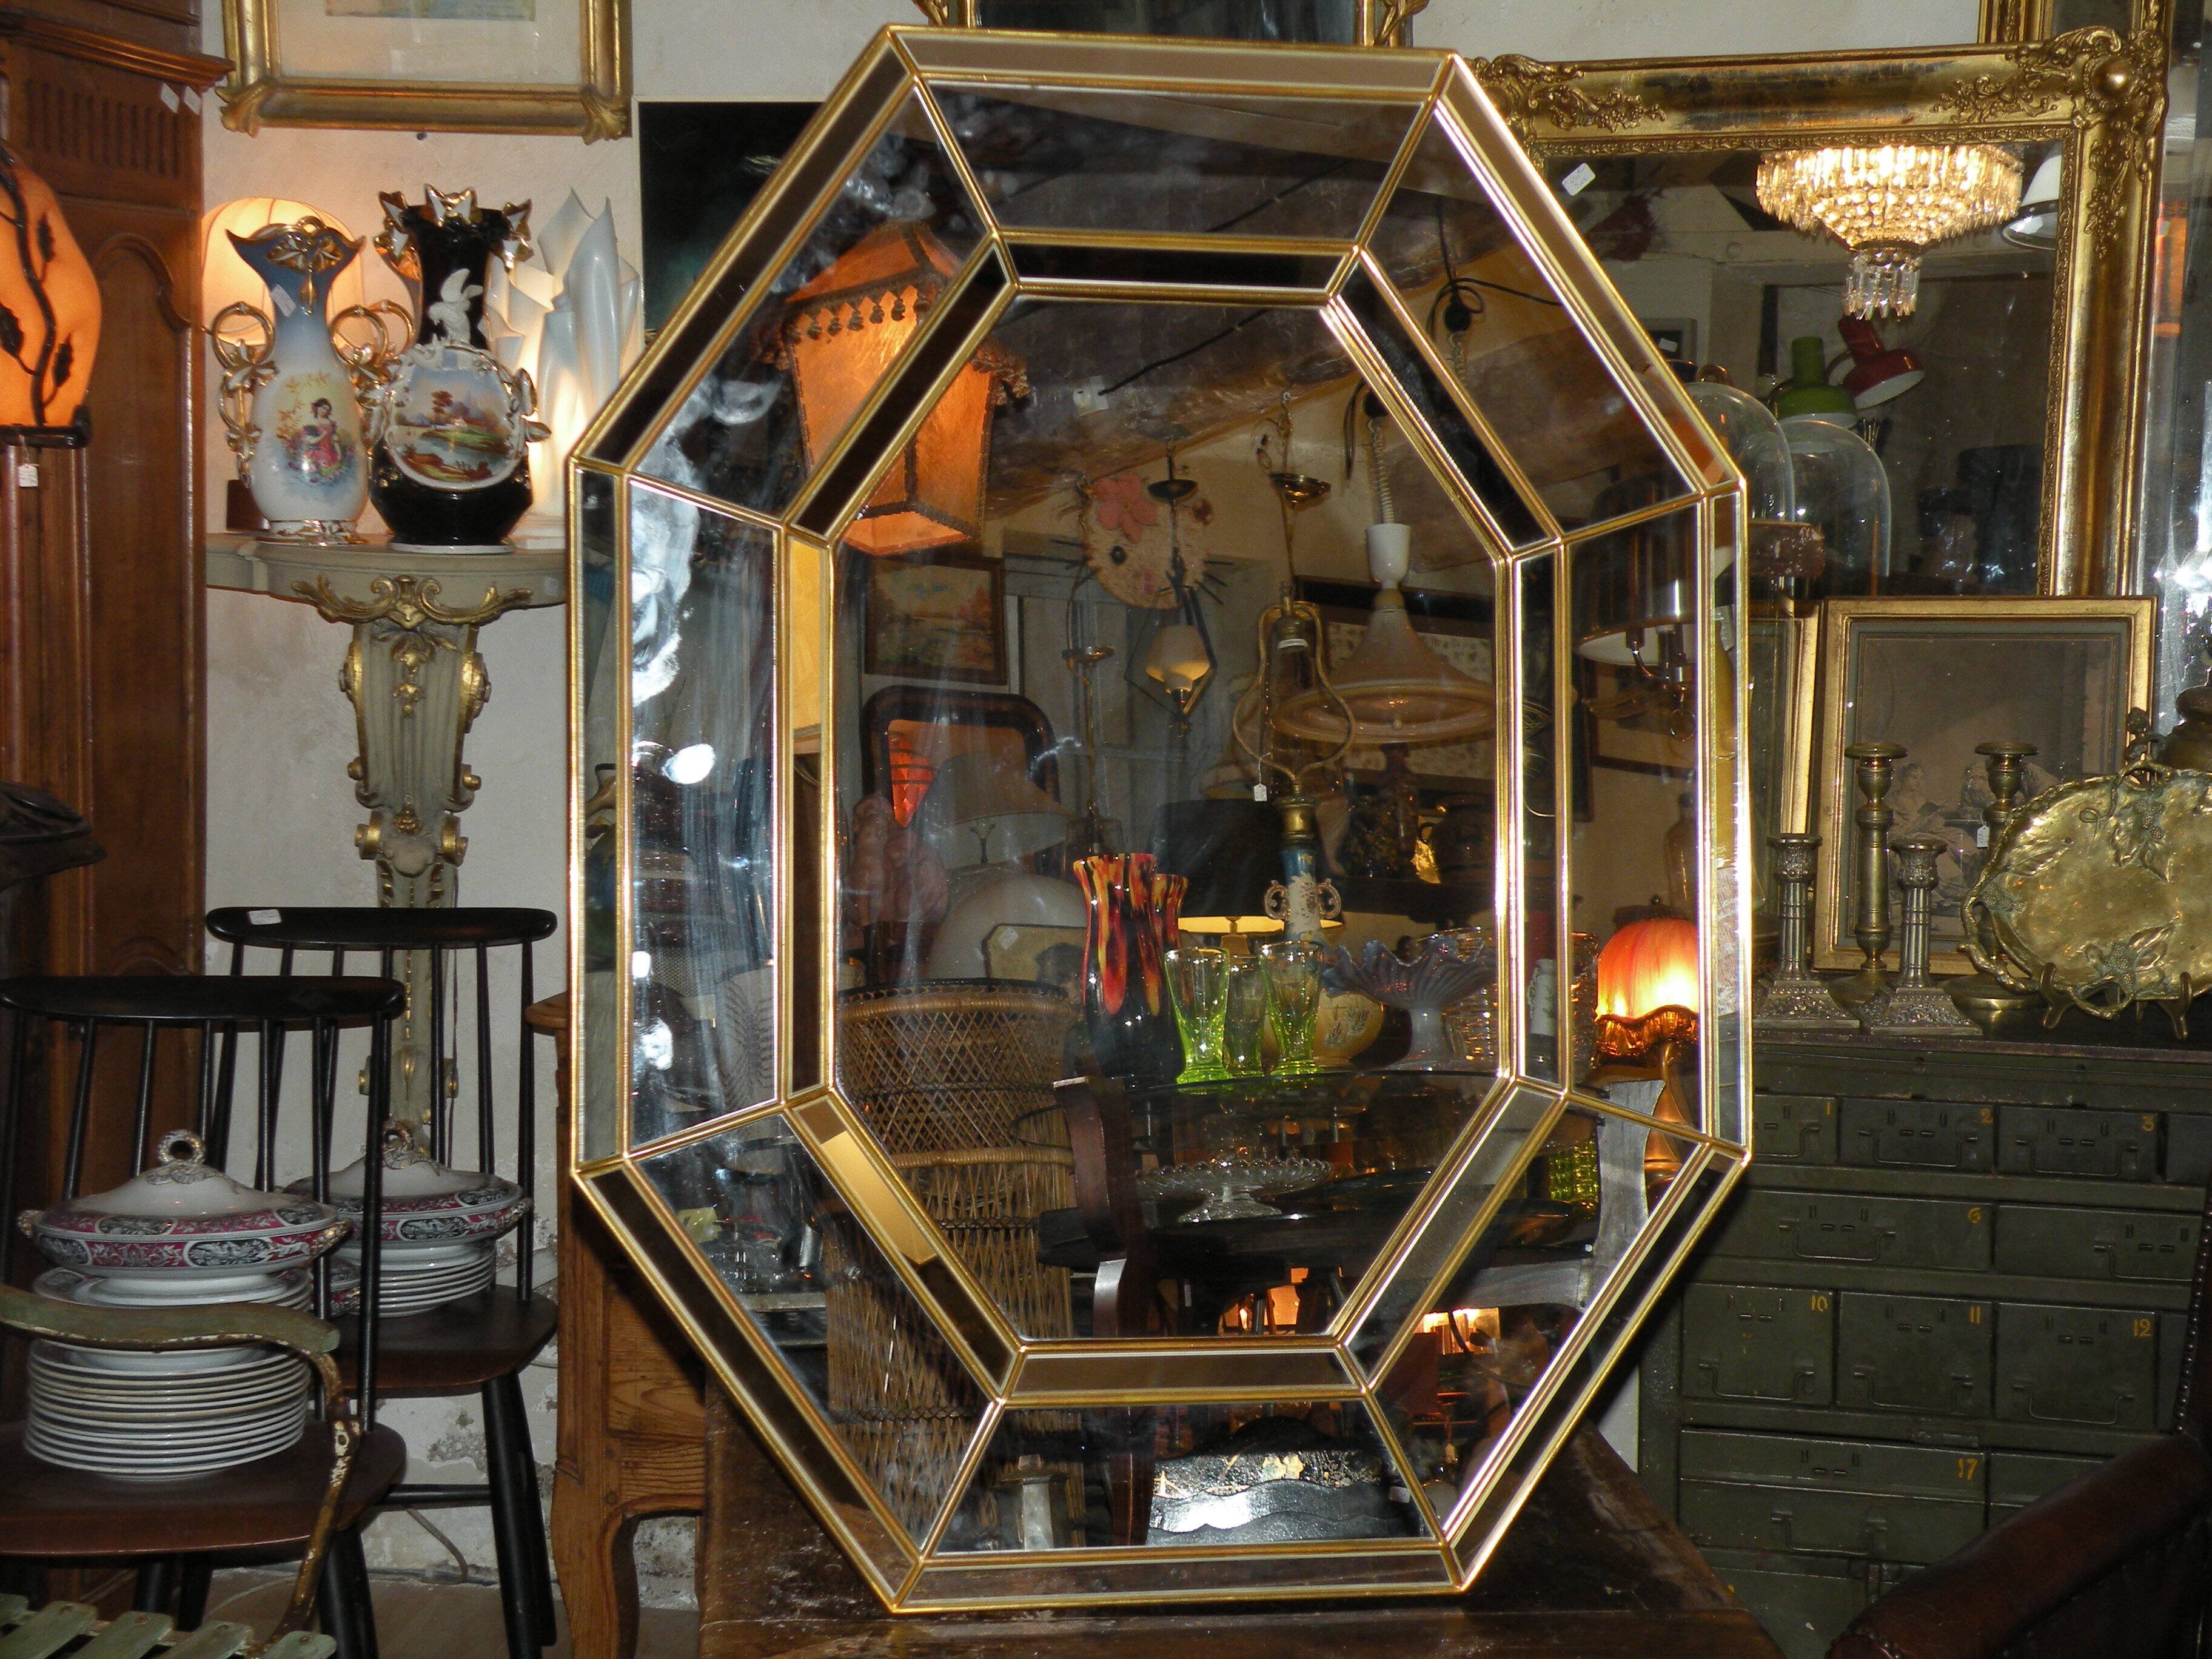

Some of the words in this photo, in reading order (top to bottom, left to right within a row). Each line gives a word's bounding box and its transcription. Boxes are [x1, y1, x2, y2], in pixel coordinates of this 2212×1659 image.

[1826, 1101, 1832, 1116] 1
[1980, 1107, 1994, 1126] 2
[2142, 1116, 2154, 1132] 3
[1968, 1207, 1982, 1224] 6
[1811, 1295, 1828, 1313] 10
[1970, 1305, 1981, 1324] 11
[2134, 1319, 2151, 1338] 12
[1958, 1458, 1977, 1480] 17
